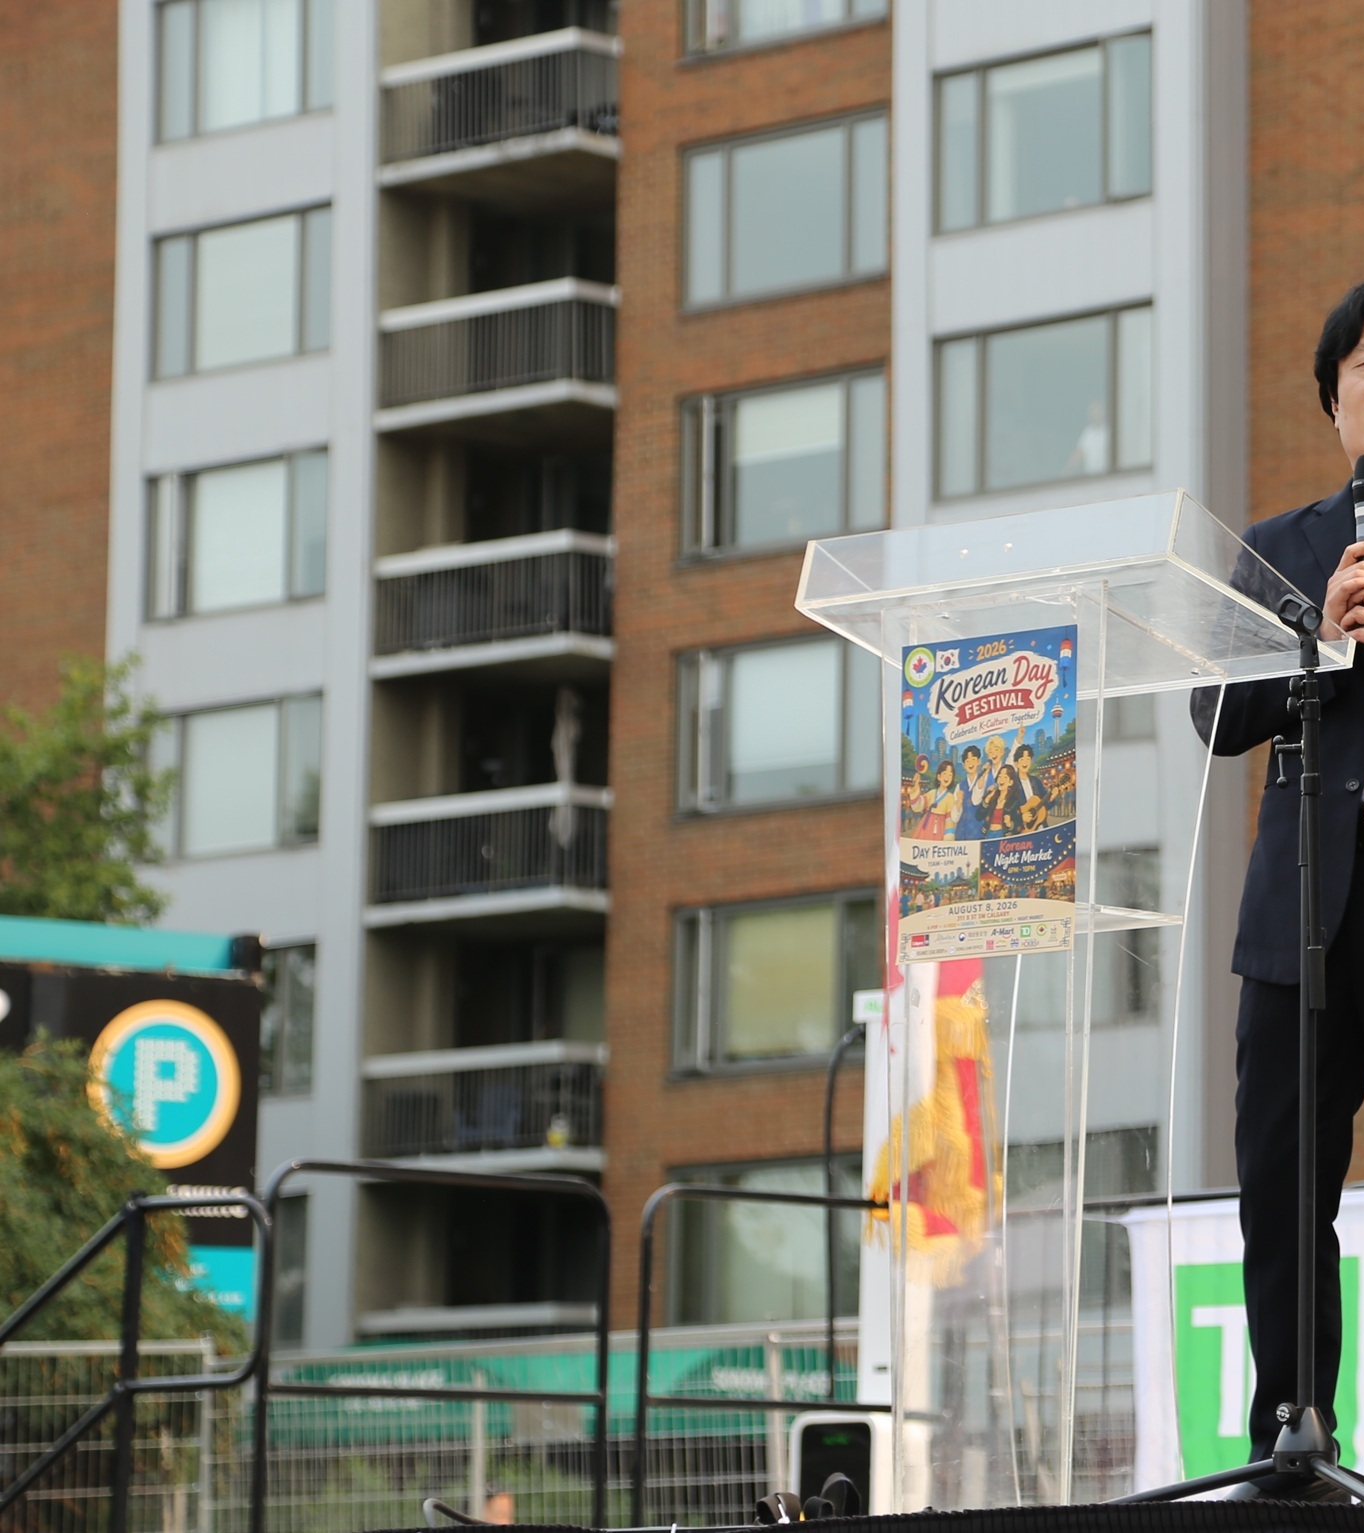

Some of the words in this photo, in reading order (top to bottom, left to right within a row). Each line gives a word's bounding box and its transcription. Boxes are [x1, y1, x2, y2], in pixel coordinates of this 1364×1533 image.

[976, 640, 1007, 660] 2026
[935, 667, 1008, 715] Korean
[1011, 655, 1054, 700] Day
[965, 691, 1025, 719] FESTIVAL
[949, 725, 977, 741] Celebrate
[978, 718, 1009, 731] K-Culture
[1010, 711, 1040, 725] Together!
[993, 853, 1019, 870] Night
[1020, 848, 1053, 864] Market
[998, 840, 1033, 854] Korean
[948, 903, 982, 916] AUGUST
[997, 901, 1018, 912] 2026
[133, 1038, 201, 1131] P
[1191, 1304, 1256, 1439] T
